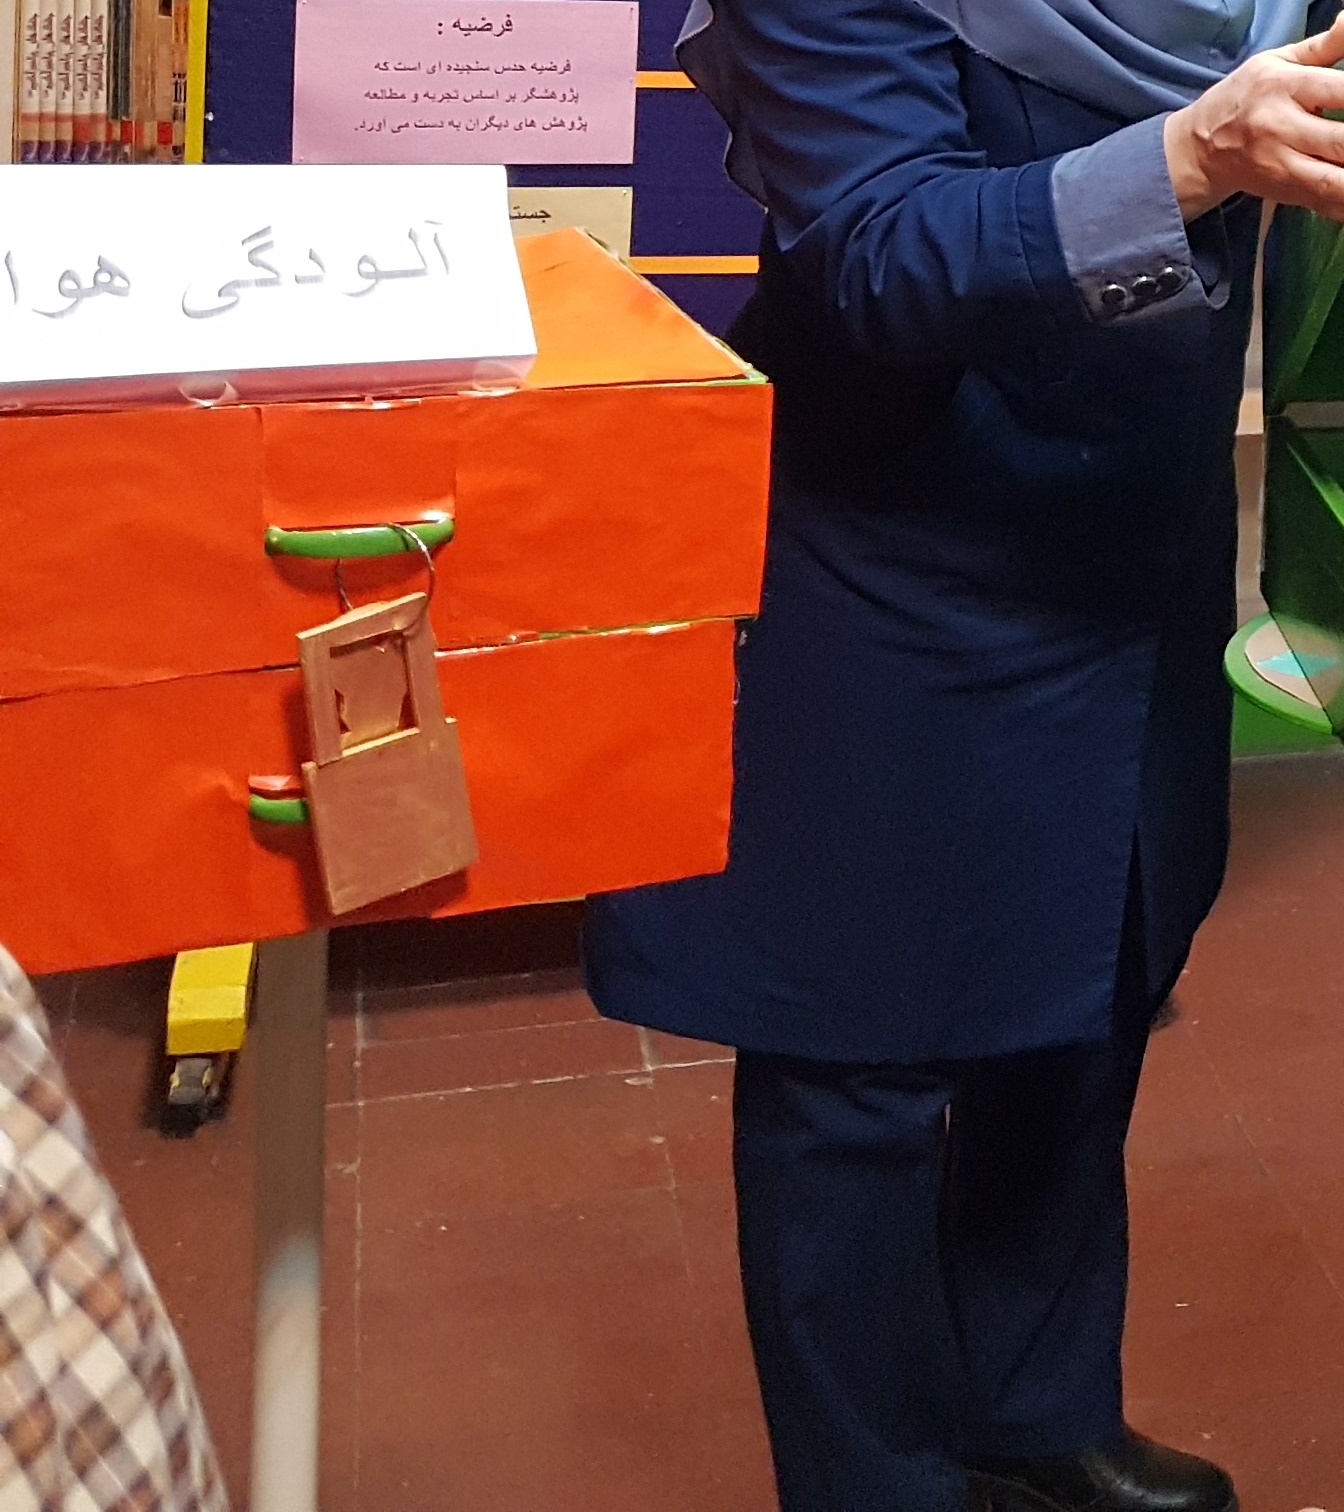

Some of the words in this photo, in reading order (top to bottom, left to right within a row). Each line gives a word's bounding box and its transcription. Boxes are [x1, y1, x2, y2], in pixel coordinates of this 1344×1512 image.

[452, 13, 513, 37] فرضیه
[374, 61, 390, 71] که
[393, 61, 421, 71] است
[426, 60, 442, 75] ای
[446, 60, 490, 75] سنجیده
[494, 63, 527, 74] حدس
[530, 59, 572, 75] فرضیه
[364, 88, 406, 100] مطالعه
[411, 92, 419, 103] و
[423, 89, 459, 103] تجربه
[463, 89, 499, 103] اساس
[505, 92, 517, 103] بر
[521, 87, 579, 104] پژوهشگر
[391, 122, 410, 133] می
[414, 119, 444, 129] دست
[448, 119, 461, 131] به
[465, 115, 509, 132] دیگران
[513, 117, 536, 131] های
[542, 115, 588, 132] پژوهش
[181, 220, 451, 319] آلودگی
[4, 250, 132, 319] هوا
